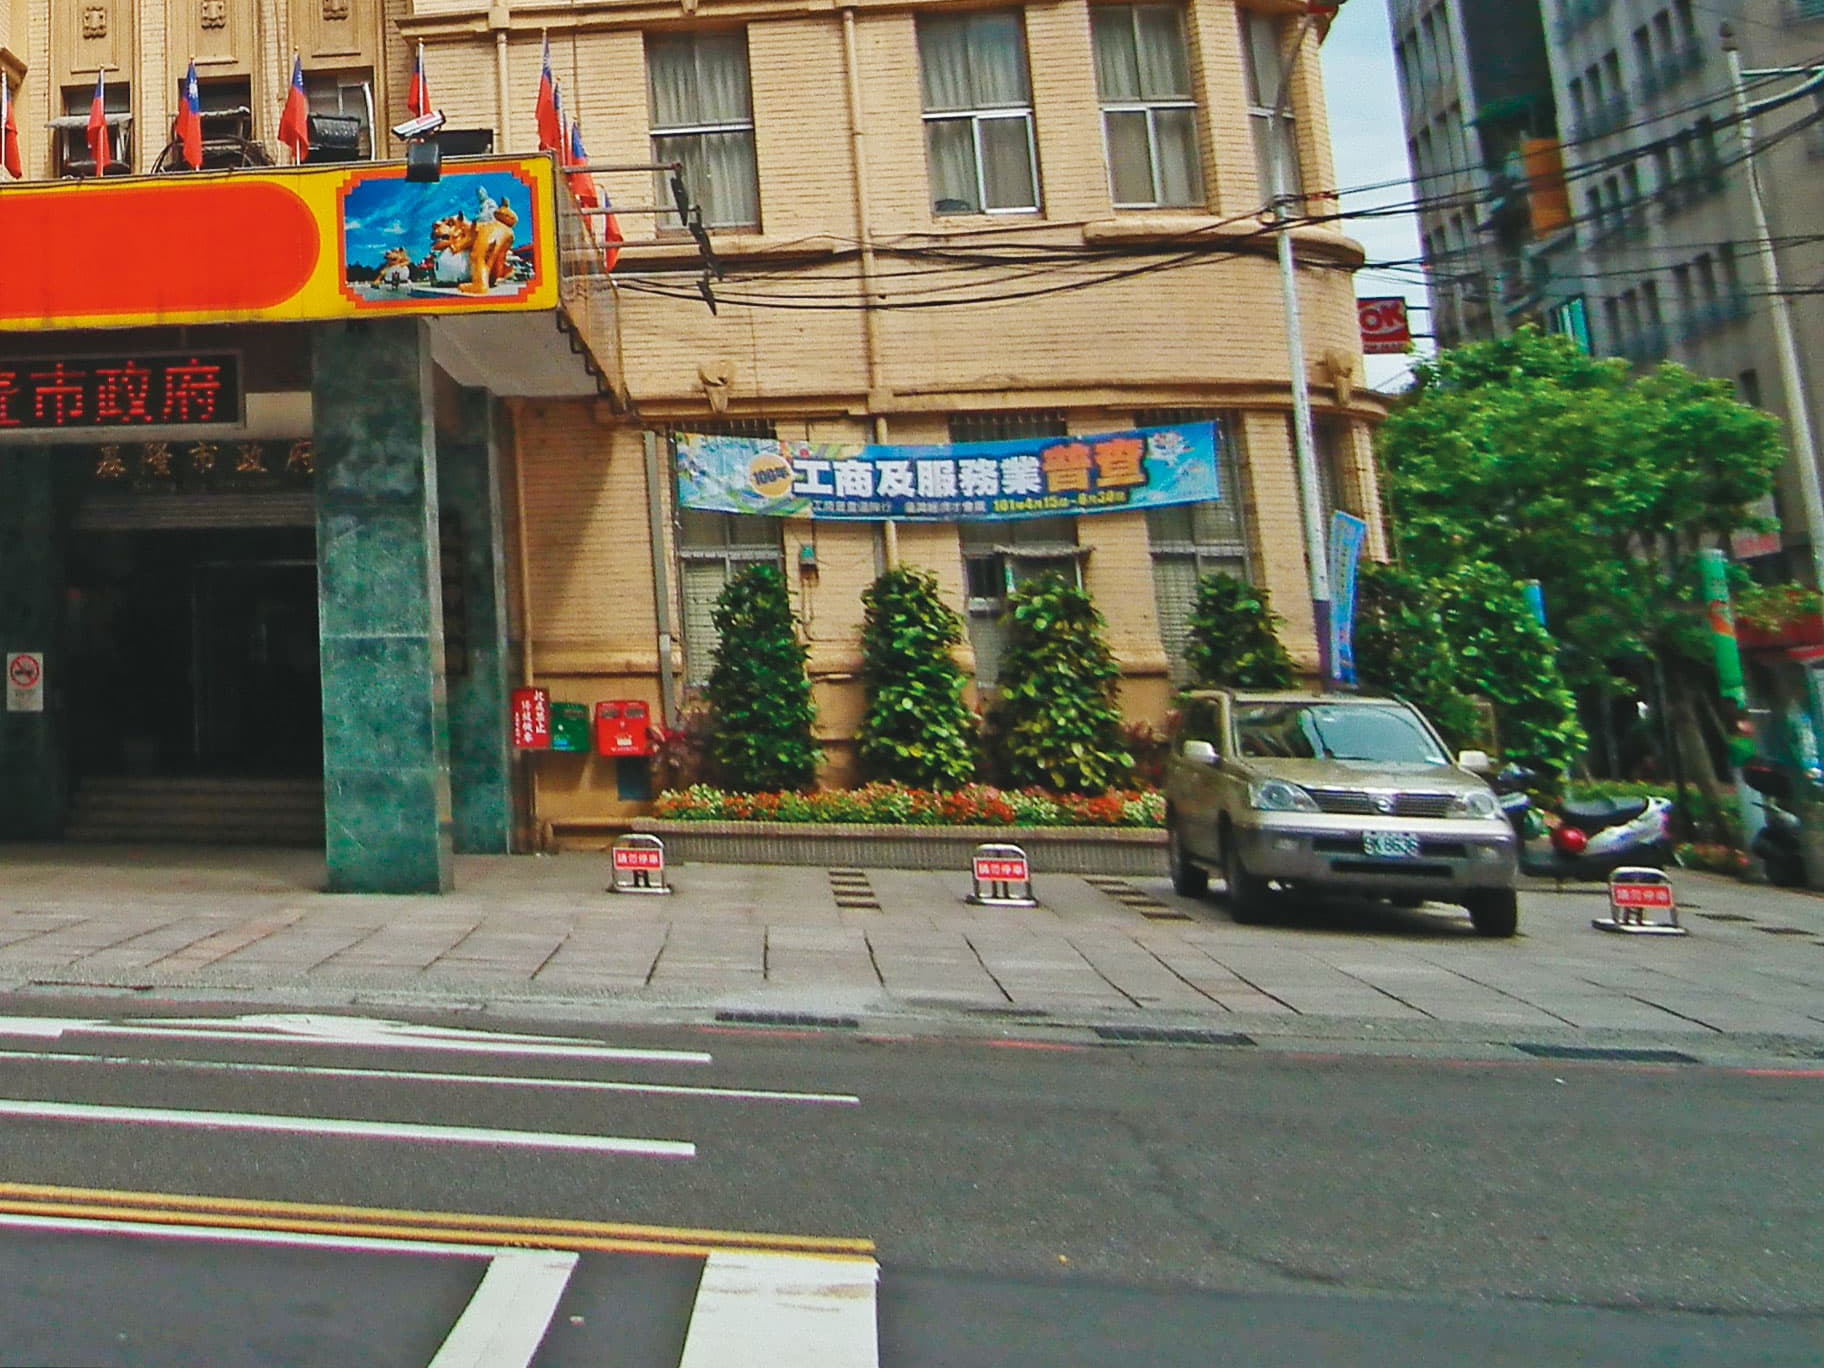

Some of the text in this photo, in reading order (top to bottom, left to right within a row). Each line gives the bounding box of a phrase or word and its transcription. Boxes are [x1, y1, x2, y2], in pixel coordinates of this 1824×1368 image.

[792, 438, 1147, 499] 工商及服務業普查
